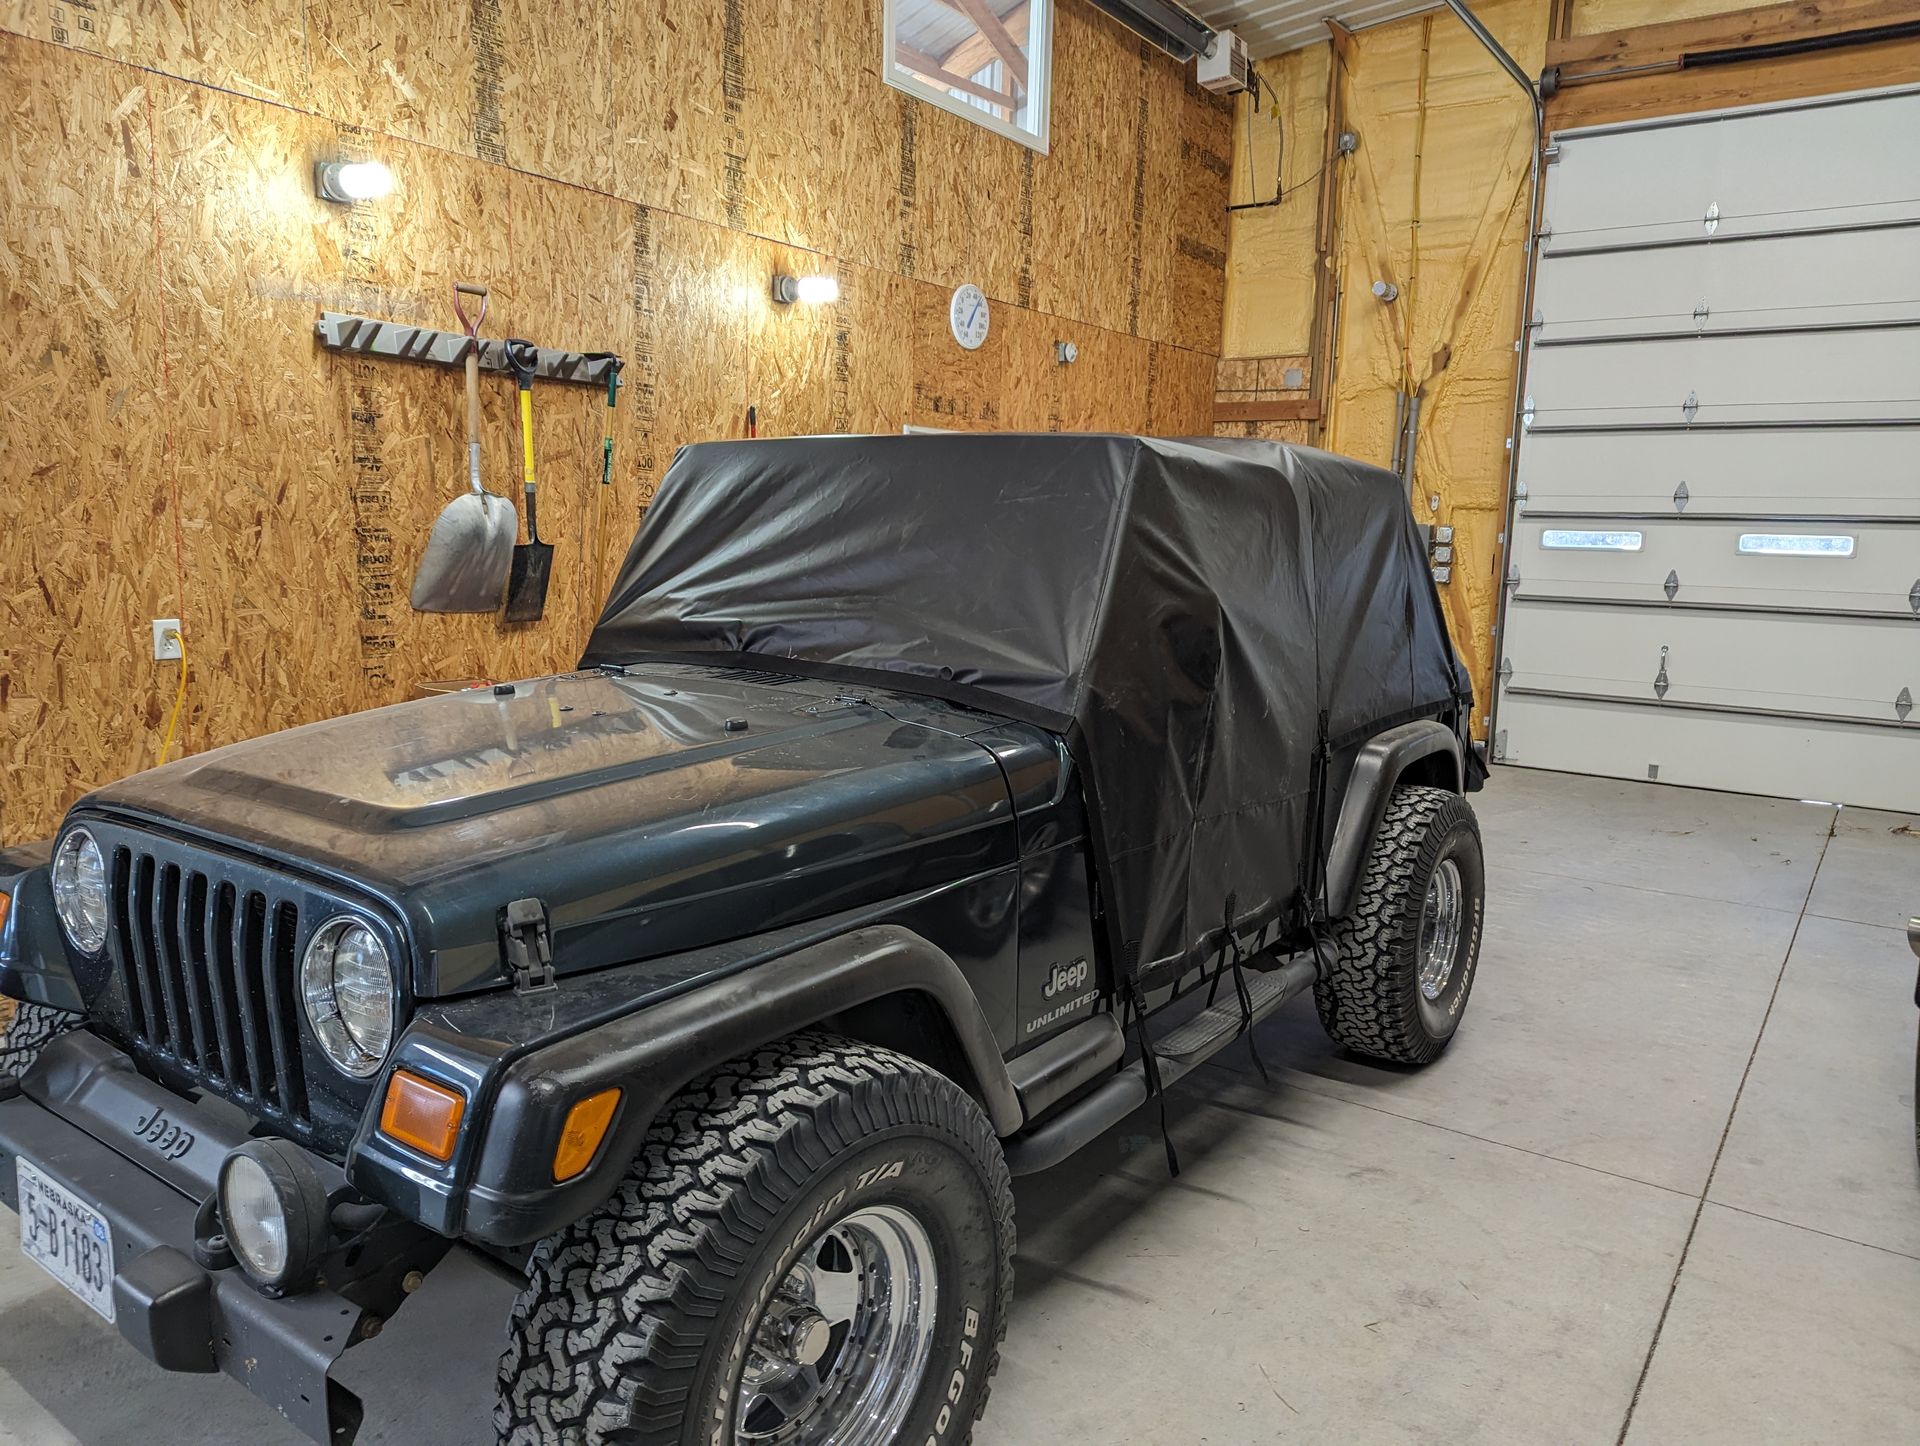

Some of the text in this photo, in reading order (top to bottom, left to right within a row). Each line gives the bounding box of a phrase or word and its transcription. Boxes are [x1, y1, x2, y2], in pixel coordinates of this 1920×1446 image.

[1044, 960, 1088, 997] Jeep
[1026, 989, 1100, 1033] UNLIMITED
[133, 1106, 195, 1161] Jeep
[855, 1160, 904, 1191] T/A
[28, 1193, 104, 1293] 5-B1183
